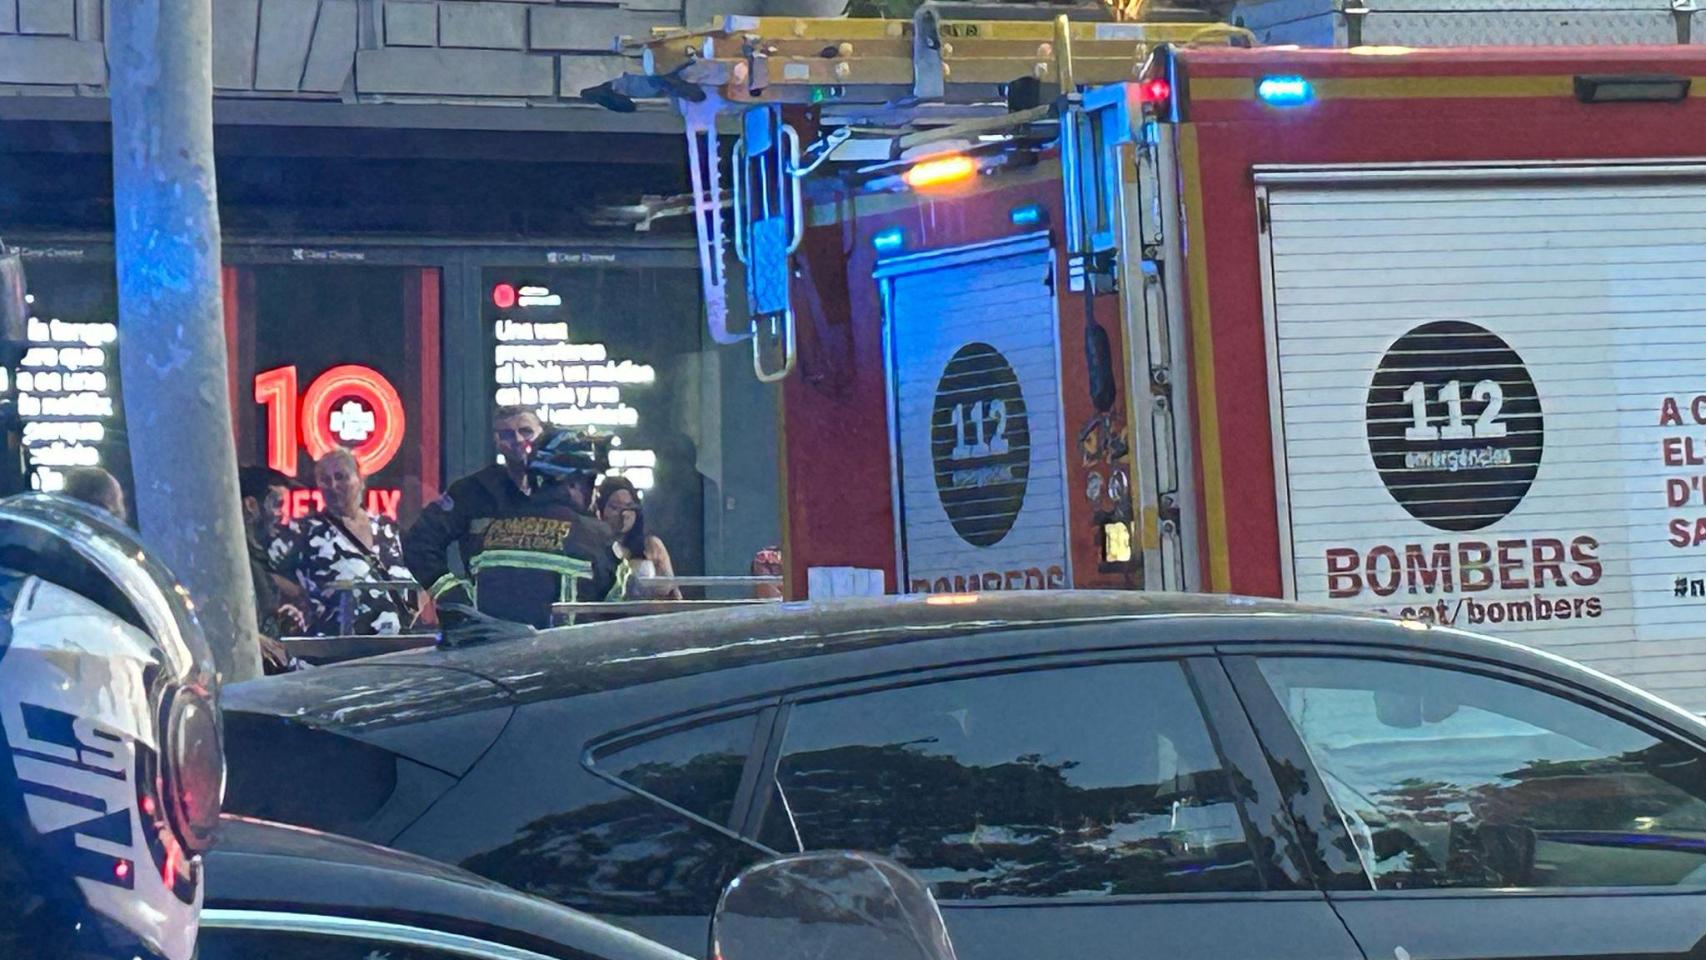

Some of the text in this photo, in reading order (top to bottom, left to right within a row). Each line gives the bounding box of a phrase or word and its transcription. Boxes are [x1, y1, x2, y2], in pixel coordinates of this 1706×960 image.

[254, 363, 405, 477] 10
[952, 398, 1010, 461] 112
[1403, 379, 1508, 441] 112
[1659, 396, 1684, 427] A
[1663, 435, 1706, 466] EL
[1667, 475, 1706, 508] D'
[1326, 535, 1603, 598] BOMBERS
